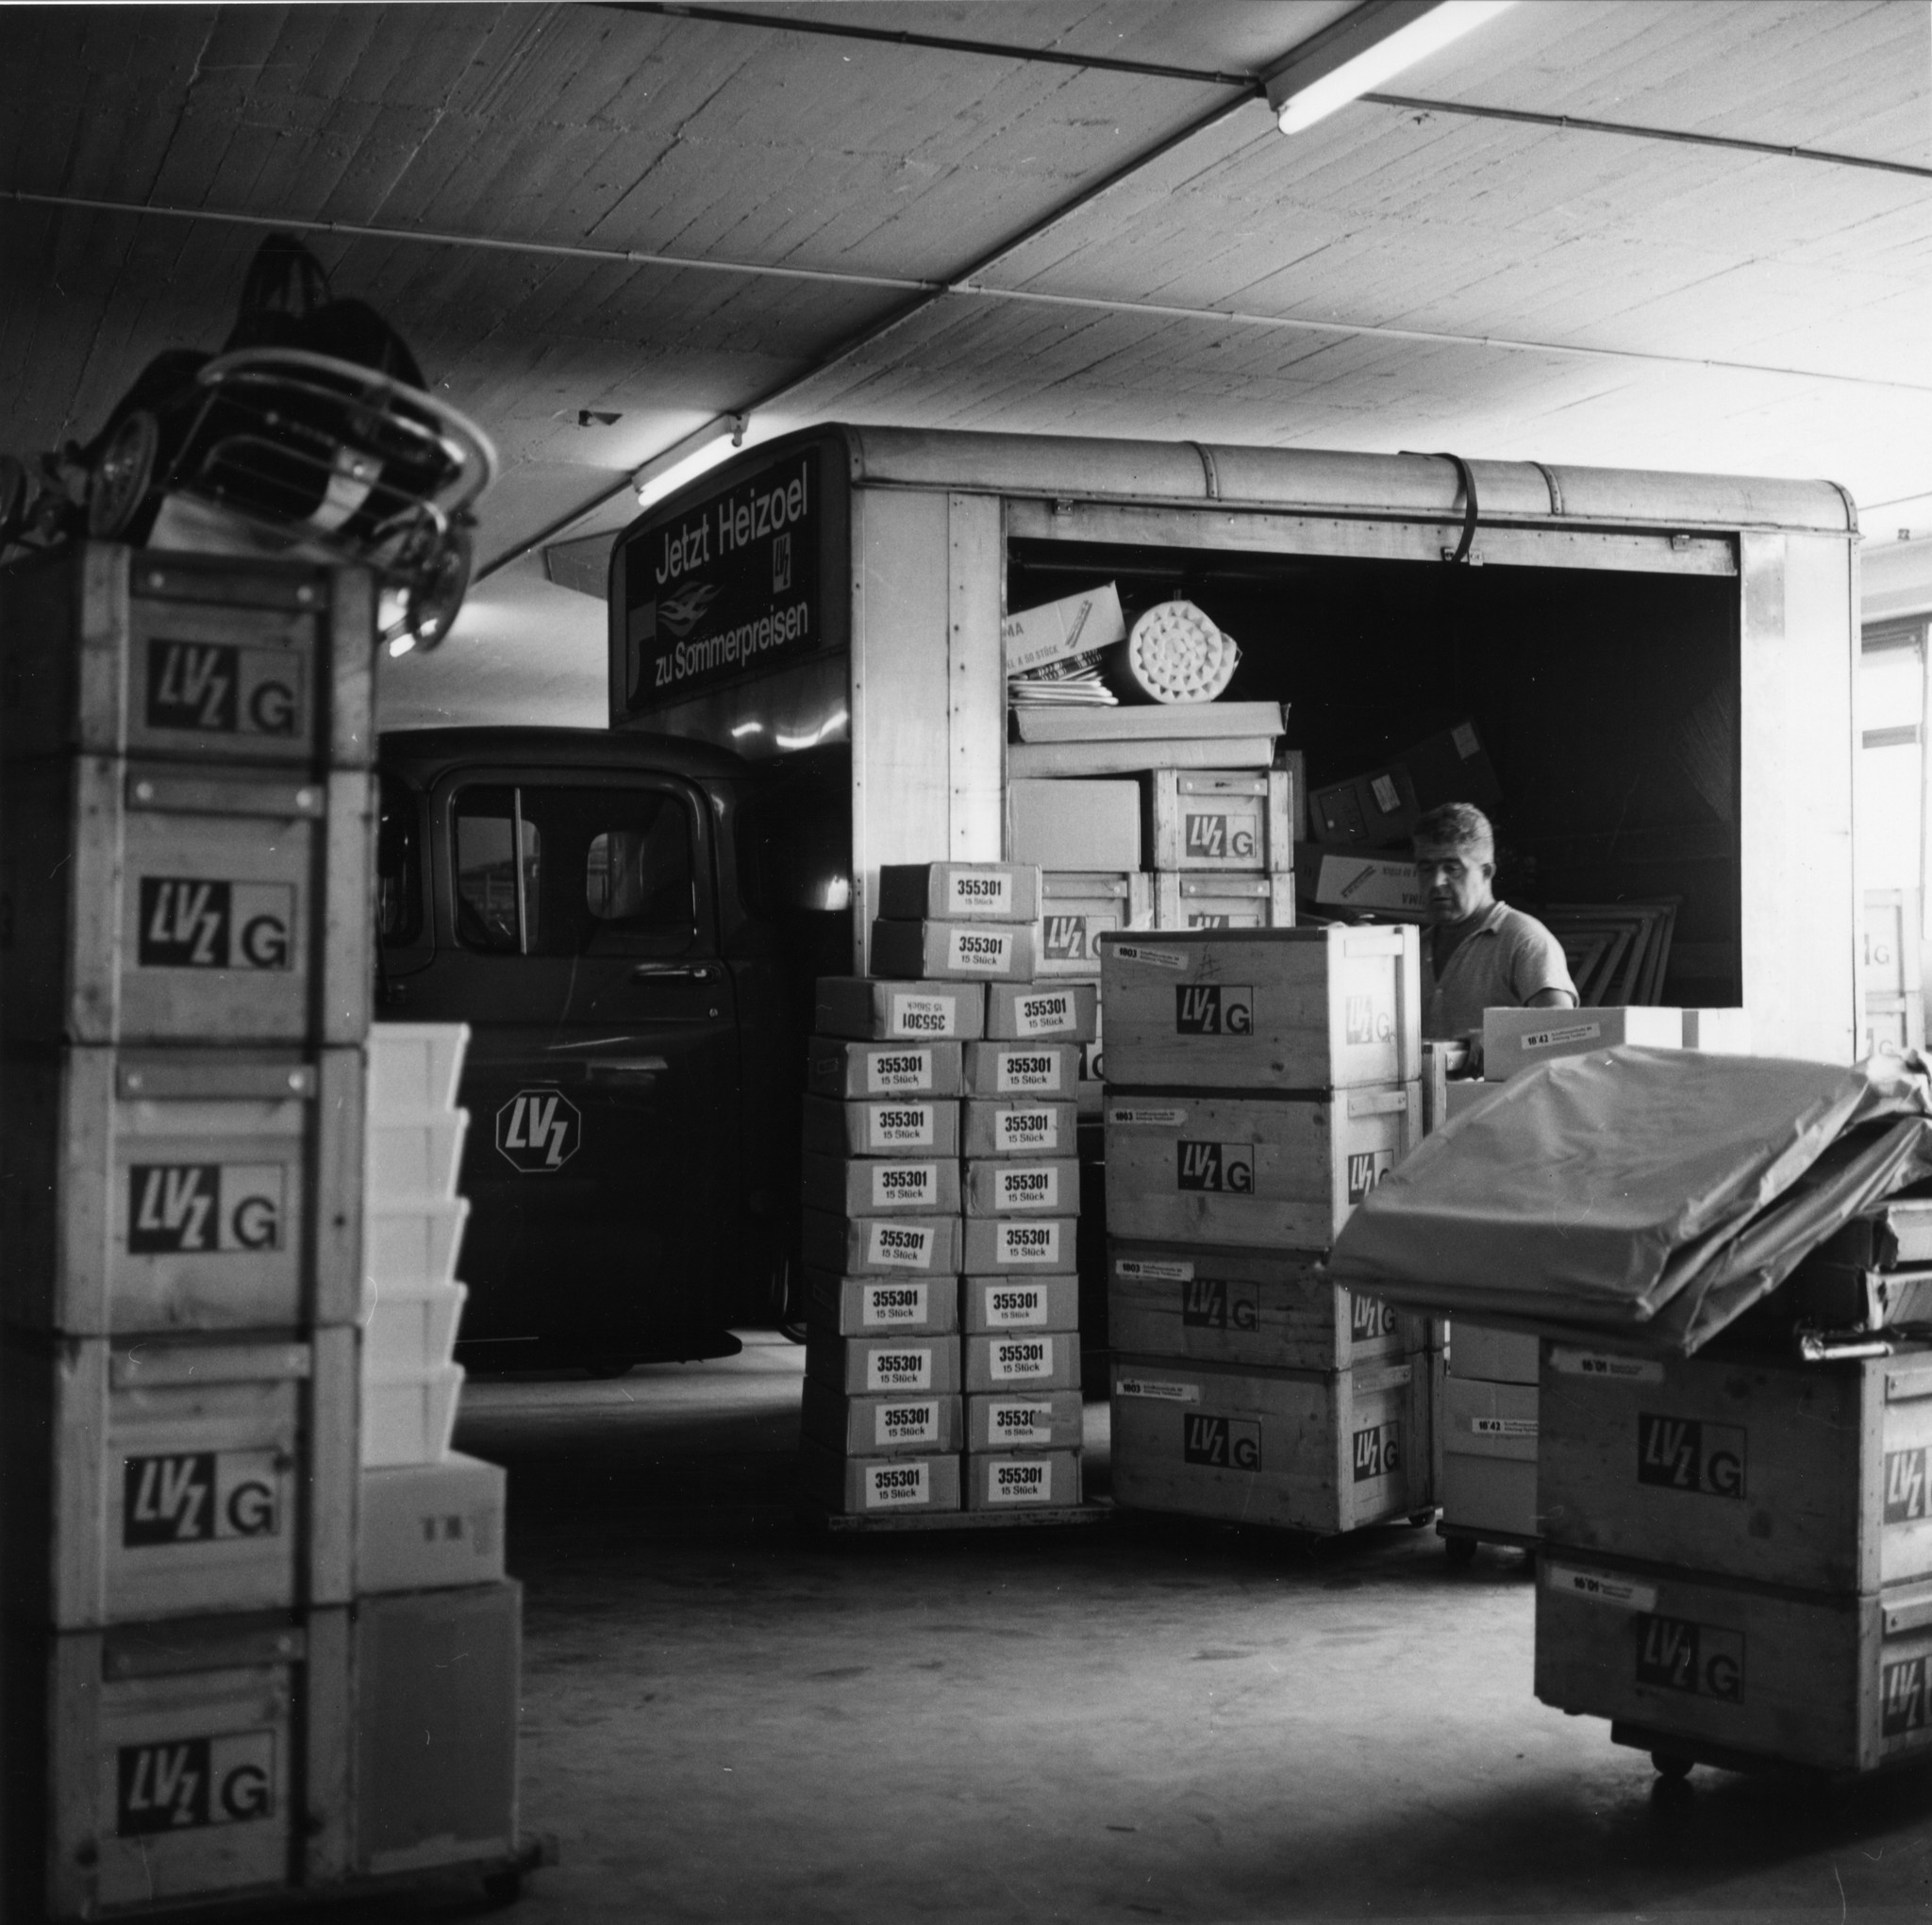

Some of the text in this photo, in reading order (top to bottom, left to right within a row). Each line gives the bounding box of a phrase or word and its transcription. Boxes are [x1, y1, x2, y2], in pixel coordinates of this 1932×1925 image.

[655, 460, 808, 585] Jetzt Heizoel
[655, 601, 808, 687] zu Sommerpreisen
[250, 680, 294, 732] G
[1231, 831, 1255, 857] G
[958, 880, 1001, 896] 355301
[242, 915, 287, 967] G
[958, 937, 1002, 954] 355301
[961, 954, 997, 966] 15 Stück
[1119, 947, 1138, 958] 1803
[907, 1002, 942, 1011] 15 Stück
[1024, 998, 1067, 1018] 355301
[903, 1013, 945, 1030] 355301
[1028, 1017, 1064, 1027] 15 Stück
[1225, 1003, 1251, 1035] G
[1376, 1012, 1391, 1043] G
[877, 1056, 922, 1073] 355301
[1007, 1056, 1051, 1073] 355301
[881, 1074, 919, 1085] 15 Stück
[1010, 1074, 1047, 1085] 15 Stück
[879, 1111, 924, 1128] 355301
[1005, 1115, 1048, 1132] 355301
[1115, 1111, 1133, 1121] 1803
[505, 1097, 568, 1165] LVZ
[883, 1128, 920, 1138] 15 Stück
[1008, 1132, 1044, 1142] 15 Stück
[882, 1170, 927, 1187] 355301
[1005, 1173, 1048, 1191] 355301
[1227, 1161, 1252, 1192] G
[886, 1188, 924, 1199] 15 Stück
[1008, 1191, 1044, 1202] 15 Stück
[233, 1196, 277, 1250] G
[879, 1230, 924, 1250] 355301
[1007, 1229, 1050, 1245] 355301
[882, 1249, 918, 1261] 15 Stück
[1009, 1247, 1046, 1256] 15 Stück
[1123, 1262, 1141, 1273] 1803
[873, 1290, 918, 1307] 355301
[993, 1292, 1038, 1309] 355301
[876, 1308, 914, 1319] 15 Stück
[1232, 1298, 1257, 1331] G
[1381, 1304, 1396, 1334] G
[999, 1344, 1043, 1362] 355301
[877, 1355, 923, 1371] 355301
[1003, 1362, 1040, 1373] 15 Stück
[891, 1372, 918, 1383] Stück
[1124, 1384, 1141, 1393] 1803
[885, 1408, 929, 1425] 355301
[889, 1426, 925, 1436] 15 Stück
[1234, 1437, 1259, 1470] G
[1384, 1440, 1399, 1471] G
[875, 1469, 920, 1488] 355301
[998, 1468, 1042, 1484] 355301
[1707, 1451, 1741, 1494] G
[879, 1487, 917, 1500] 15 Stück
[1012, 1485, 1038, 1495] Stück
[227, 1481, 273, 1536] G
[1706, 1654, 1740, 1697] G
[221, 1765, 269, 1820] G
